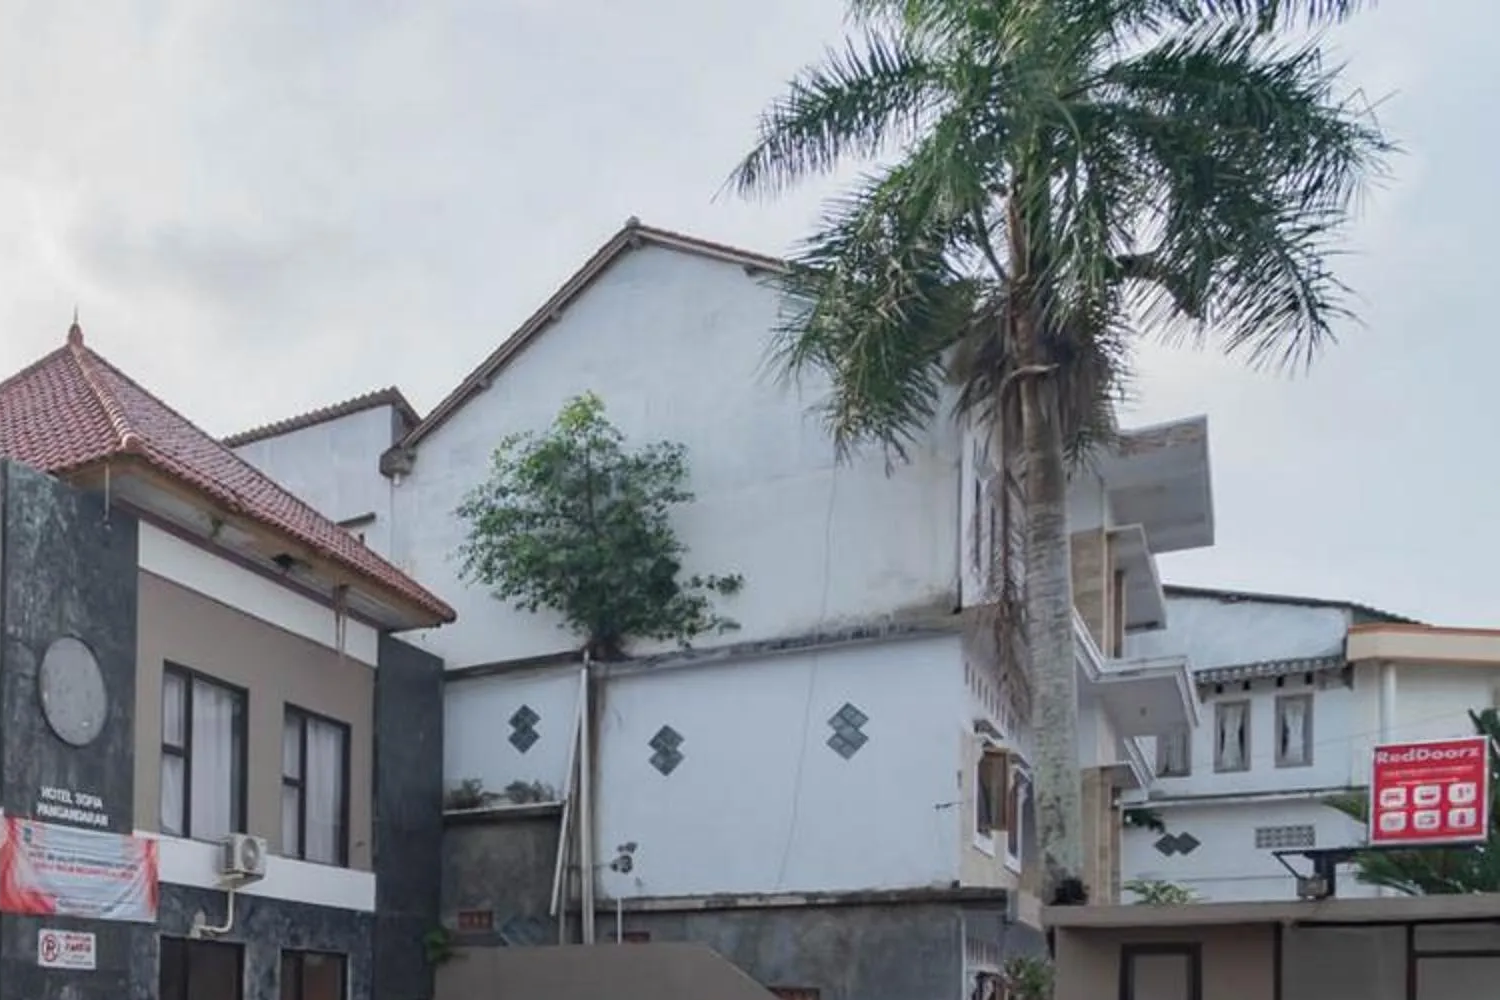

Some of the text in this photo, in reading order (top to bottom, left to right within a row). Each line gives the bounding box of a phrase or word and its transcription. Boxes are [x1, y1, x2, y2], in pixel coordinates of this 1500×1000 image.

[1376, 747, 1480, 764] RedDoorz
[41, 785, 103, 811] HOTEL SOFIA
